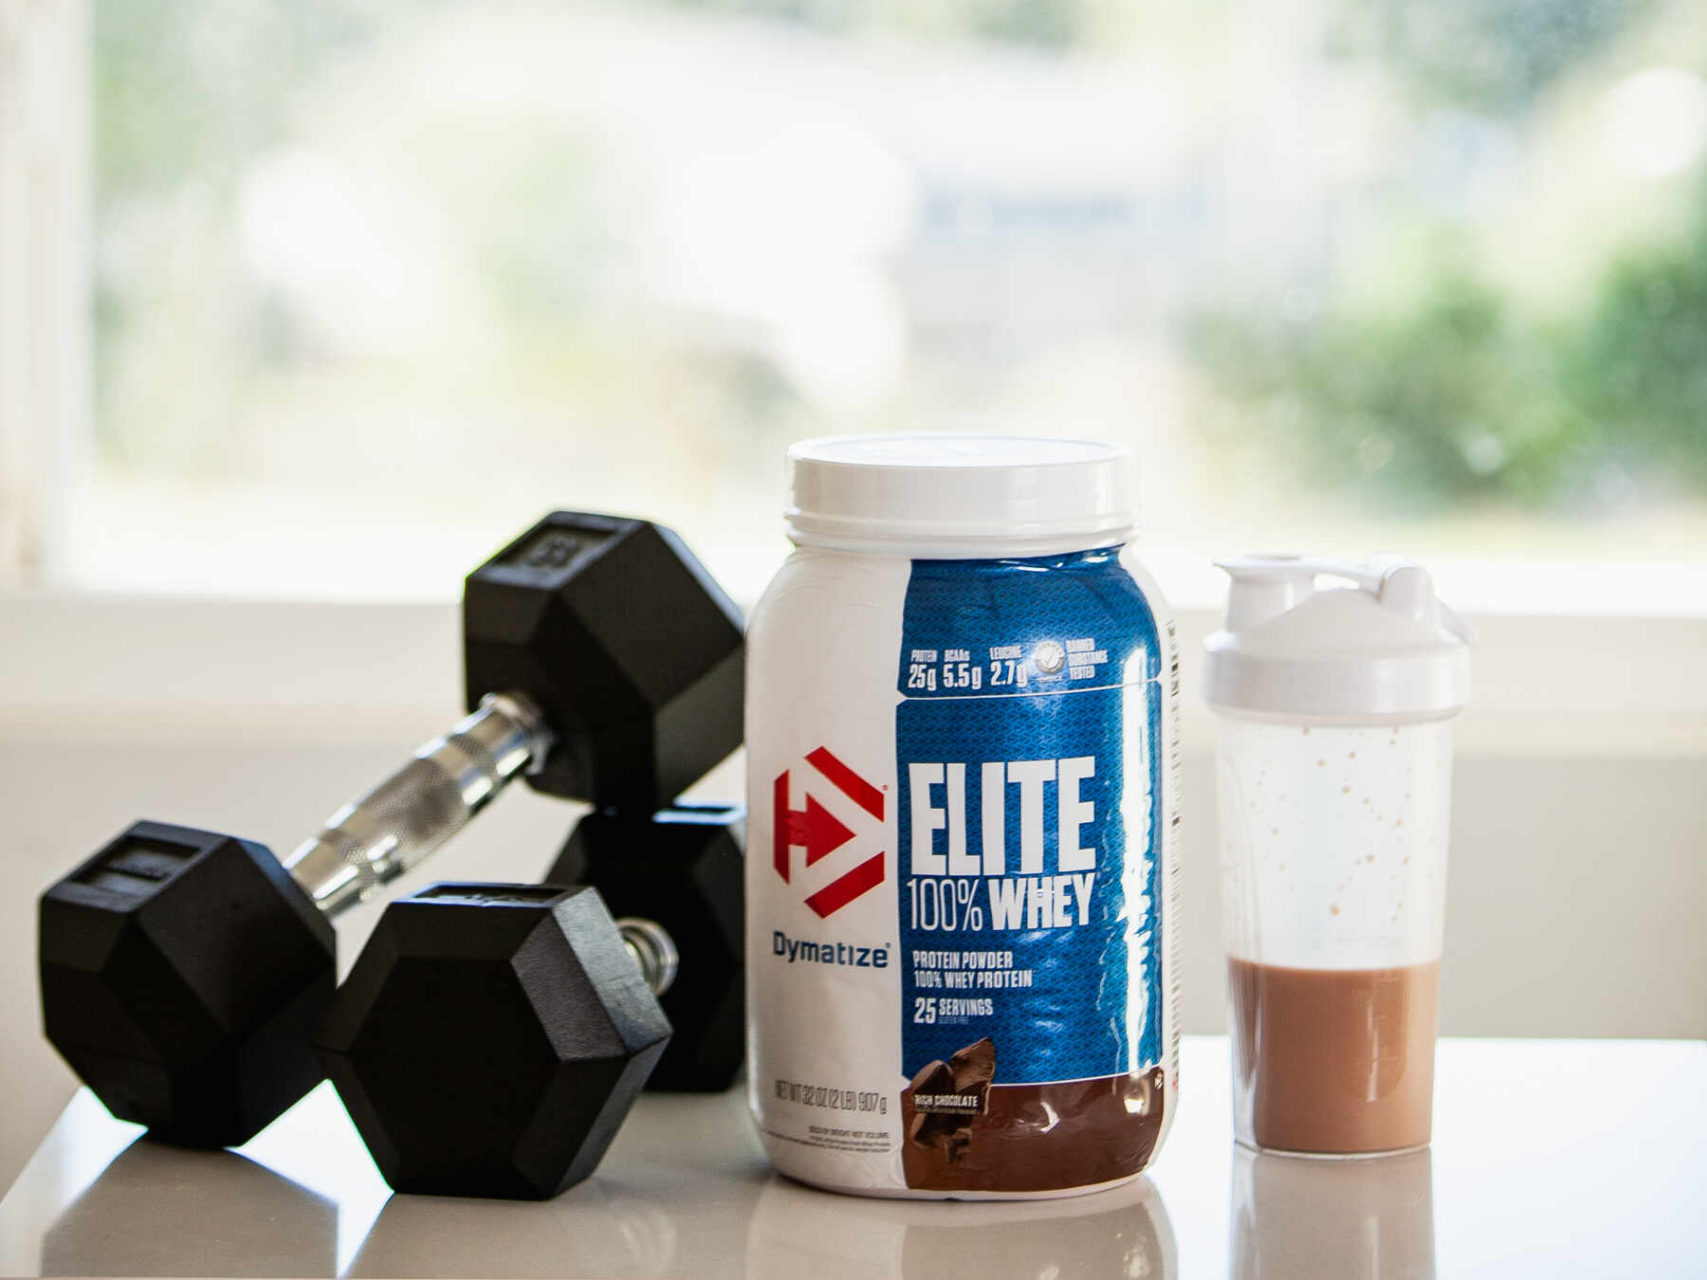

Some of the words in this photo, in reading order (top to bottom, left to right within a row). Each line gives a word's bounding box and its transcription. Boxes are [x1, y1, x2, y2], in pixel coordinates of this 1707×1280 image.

[908, 664, 937, 691] 25g
[943, 663, 982, 690] 5.5g
[990, 660, 1028, 688] 2.7g
[908, 756, 1096, 876] ELITE
[907, 878, 983, 931] 100%
[988, 872, 1095, 930] WHEY
[773, 931, 888, 968] Dymatize
[912, 950, 960, 969] PROTEIN
[962, 950, 1013, 969] POWDER
[914, 970, 942, 988] 100%
[944, 971, 975, 989] WHEY
[976, 969, 1033, 989] PROTEIN
[914, 997, 937, 1024] 25
[938, 997, 994, 1016] SERVINGS
